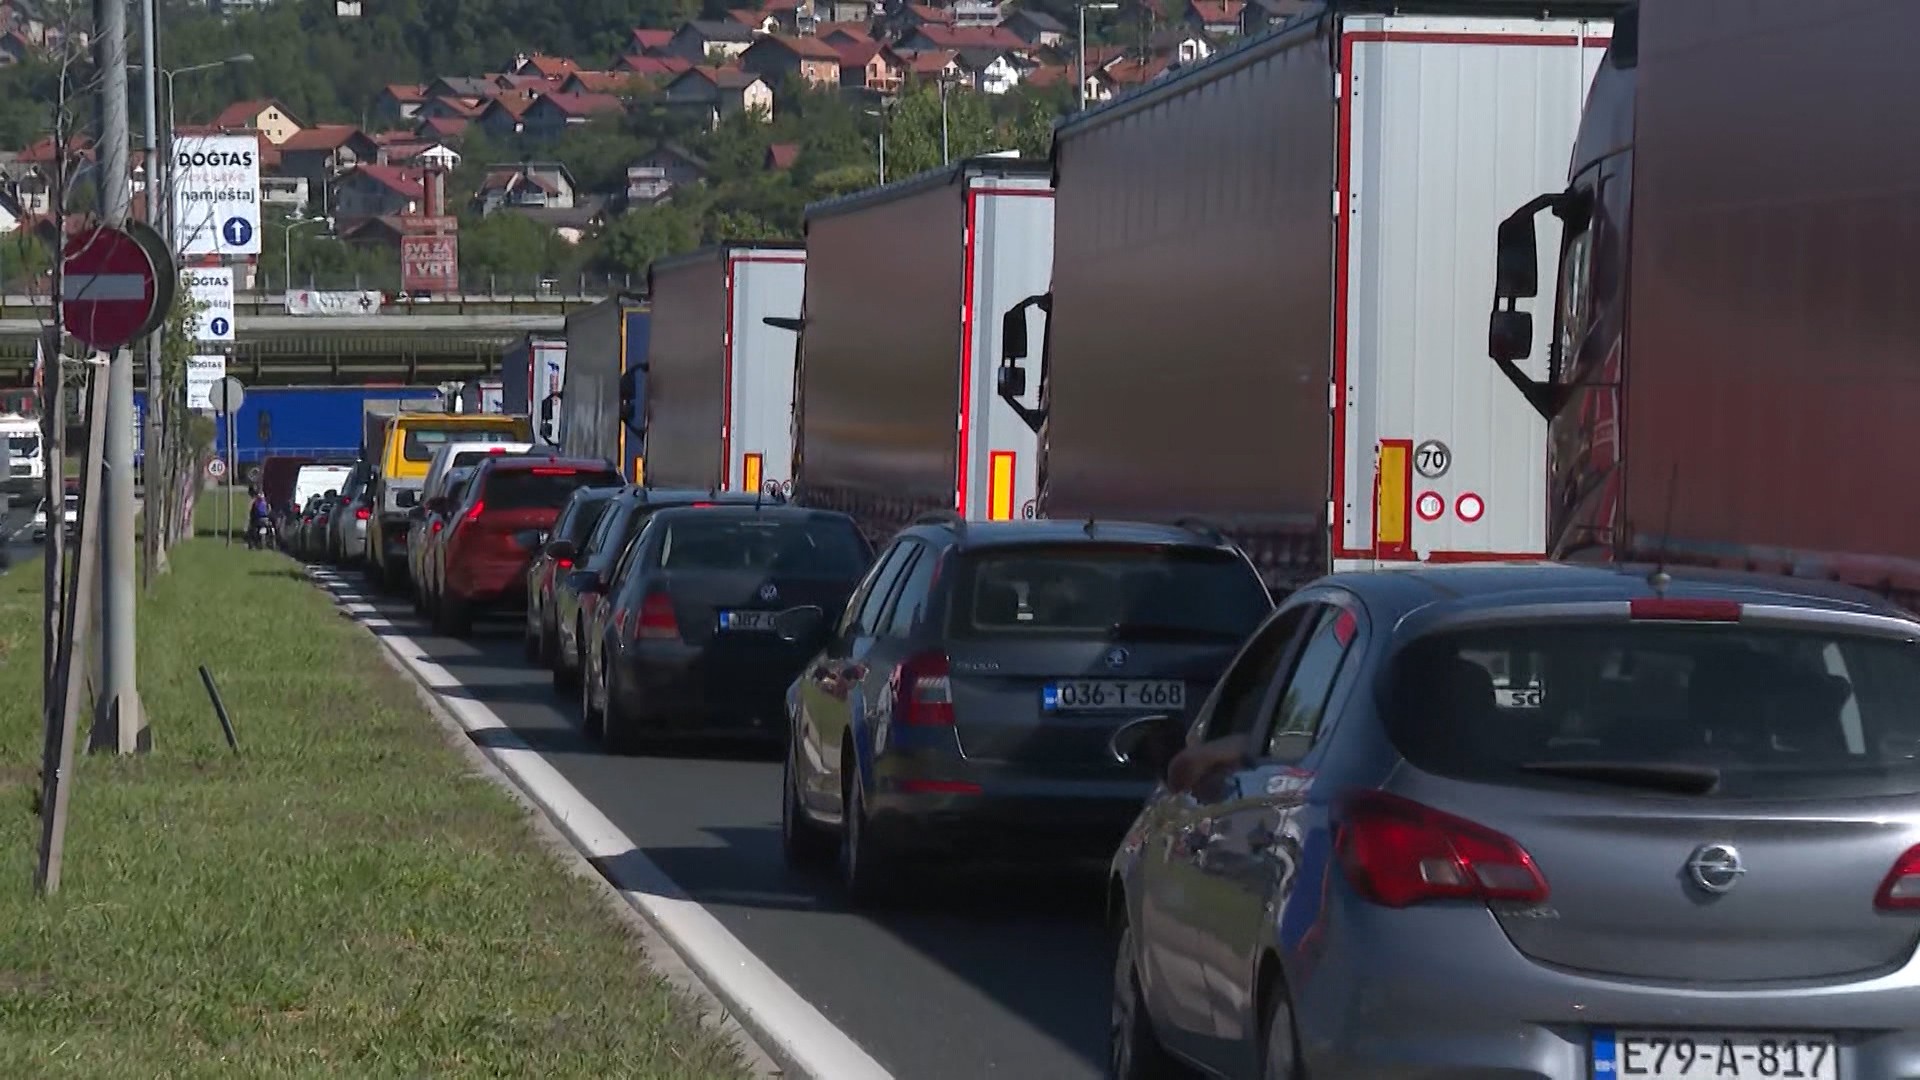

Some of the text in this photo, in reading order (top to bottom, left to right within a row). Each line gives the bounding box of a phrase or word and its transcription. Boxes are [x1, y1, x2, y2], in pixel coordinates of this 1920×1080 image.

[182, 188, 255, 203] namještaj
[433, 242, 453, 254] ZA
[416, 262, 454, 276] VRT
[1421, 451, 1444, 468] 70
[211, 463, 222, 472] 40
[1063, 683, 1181, 705] 036-T-668
[1623, 1038, 1829, 1077] E79-A-817
